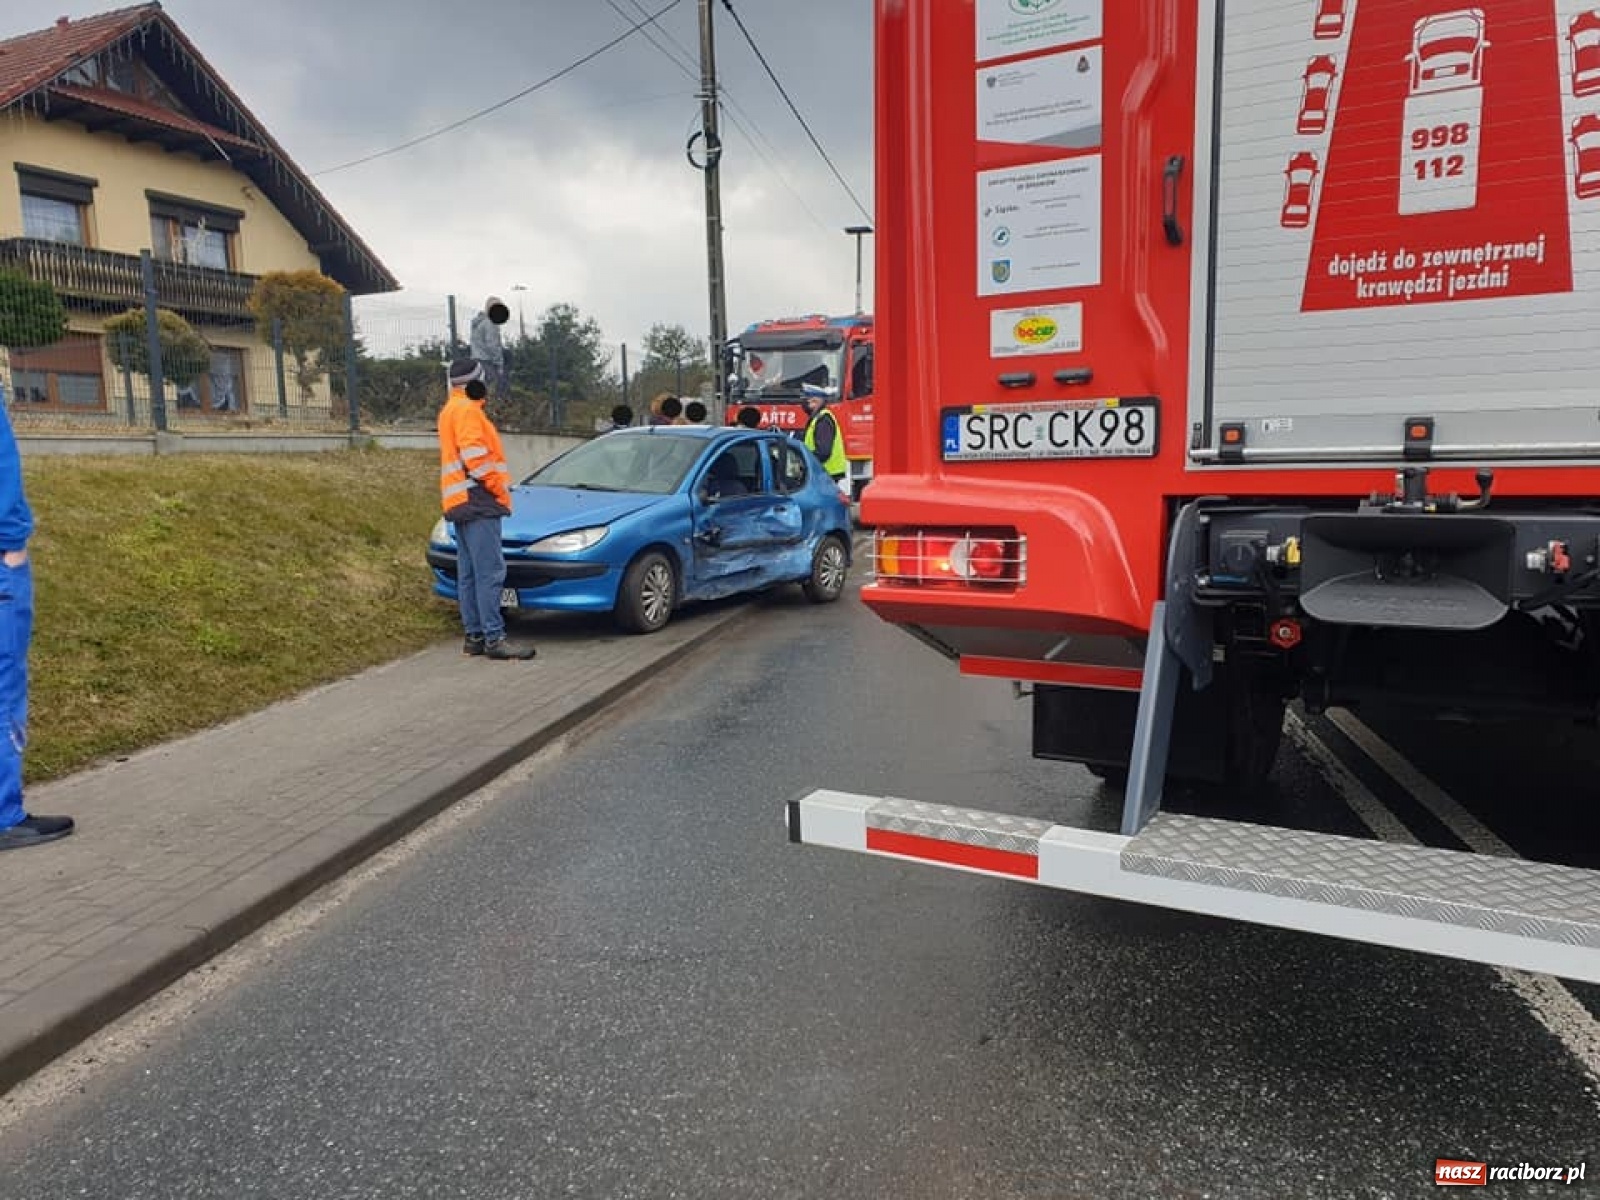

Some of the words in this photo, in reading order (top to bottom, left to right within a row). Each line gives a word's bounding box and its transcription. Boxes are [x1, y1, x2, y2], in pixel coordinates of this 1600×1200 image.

[1411, 122, 1469, 150] 998
[1414, 154, 1465, 180] 112
[1328, 252, 1387, 280] dojedź
[1393, 247, 1416, 269] do
[1422, 233, 1546, 269] zewnętrznej
[1357, 269, 1443, 301] krawędzi
[1448, 263, 1509, 298] jezdni
[966, 413, 1033, 450] SRC
[1049, 408, 1145, 448] CK98
